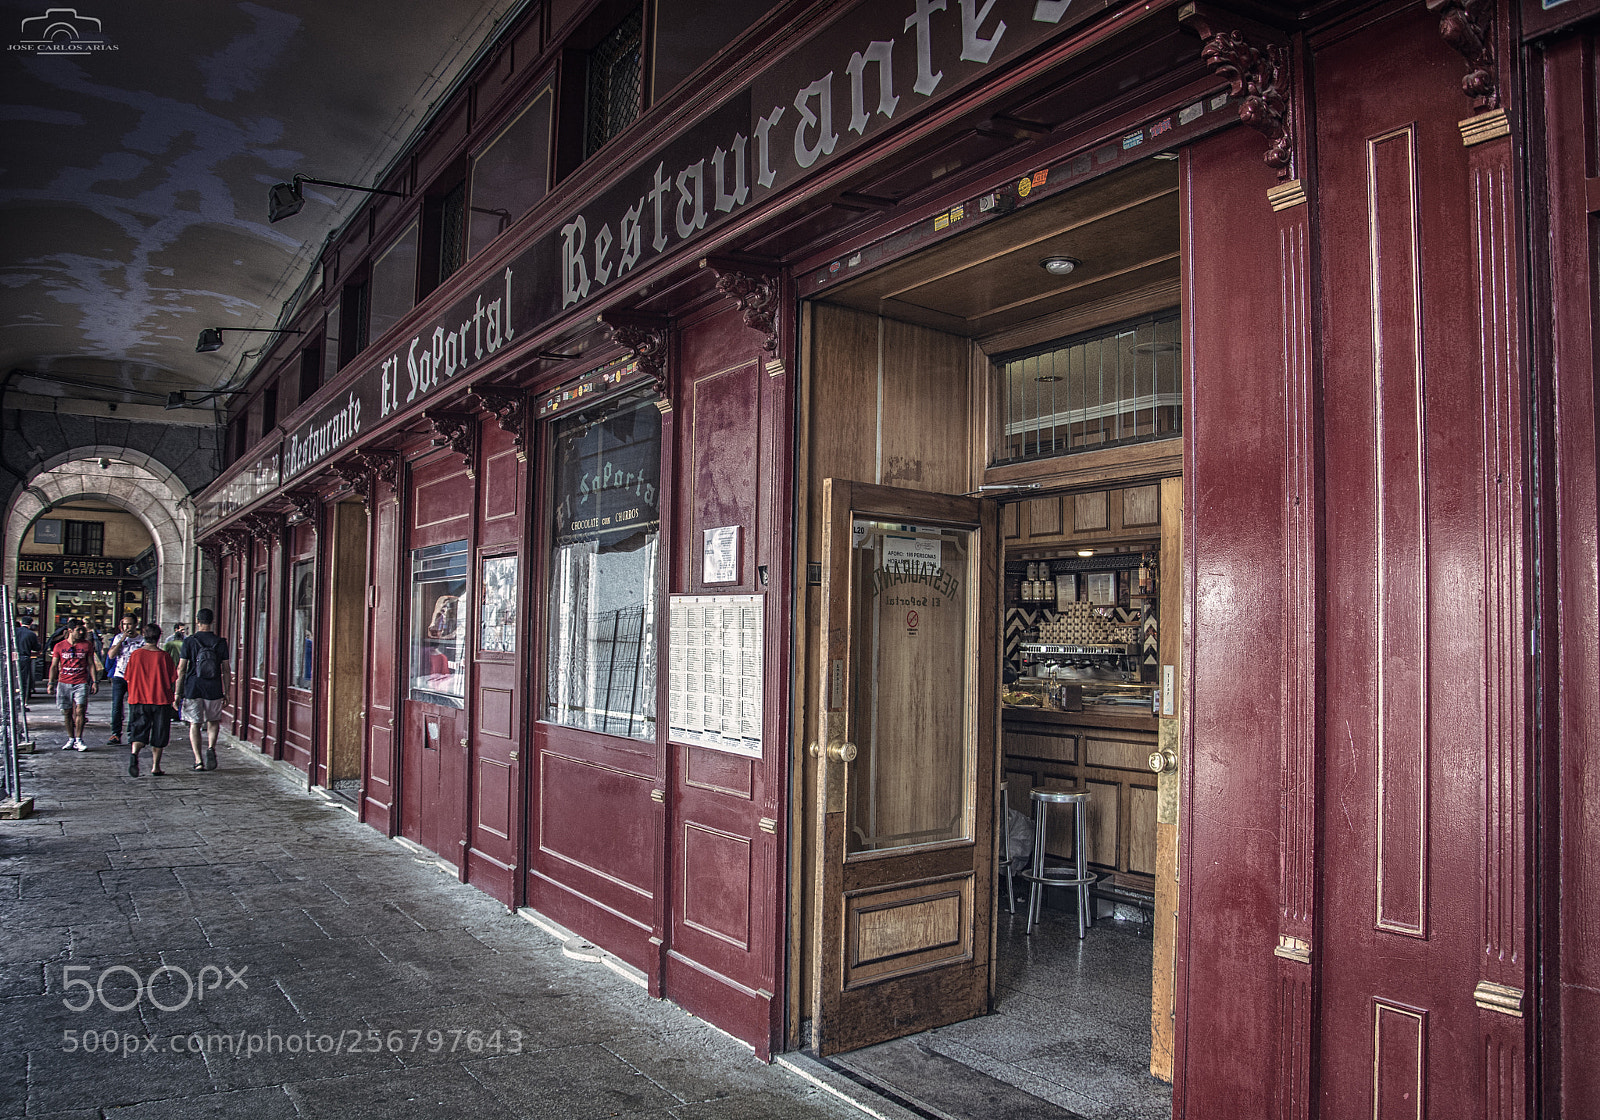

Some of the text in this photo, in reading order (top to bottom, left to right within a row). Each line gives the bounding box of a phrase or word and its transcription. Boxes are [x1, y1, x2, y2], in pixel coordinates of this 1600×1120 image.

[381, 354, 398, 418] El
[561, 0, 1006, 310] Restaurante
[290, 391, 361, 476] Restaurante
[580, 462, 659, 508] SoPorta
[571, 517, 599, 531] CHOCOLATE
[615, 507, 639, 523] CHURROS
[63, 560, 113, 570] FABRICA
[63, 568, 113, 576] GORRAS
